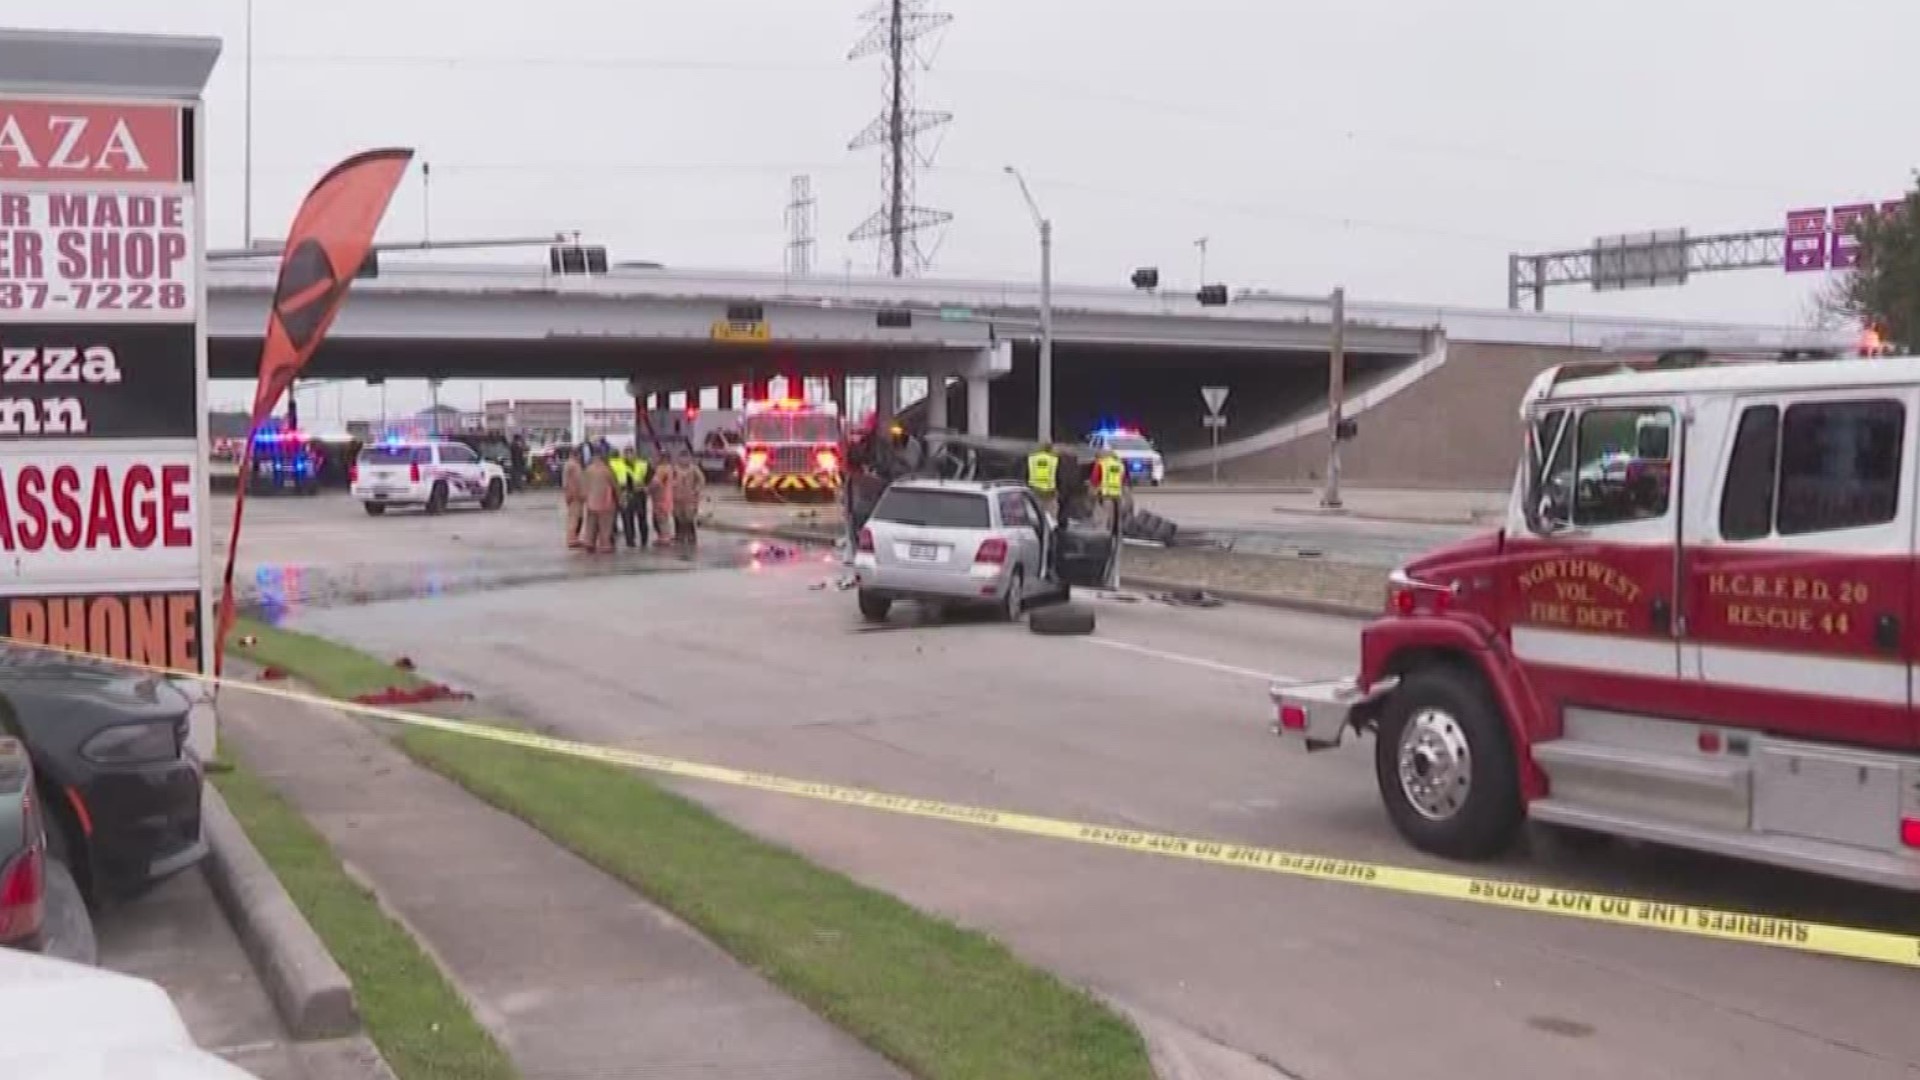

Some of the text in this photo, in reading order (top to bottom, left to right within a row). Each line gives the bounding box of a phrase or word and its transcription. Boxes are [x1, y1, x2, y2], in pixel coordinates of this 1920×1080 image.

[0, 114, 149, 172] AZA
[1, 194, 183, 228] R MADE
[57, 231, 186, 280] SHOP
[0, 282, 186, 310] 37-7228
[1518, 559, 1640, 603] NORTHWEST
[1839, 580, 1869, 604] 20
[1531, 602, 1571, 623] FIRE
[1727, 604, 1848, 634] RESCUE 44
[1469, 881, 1541, 904] CROSS
[1548, 890, 1592, 911] NOT
[1600, 898, 1630, 917] DO
[1637, 902, 1688, 925] LINE
